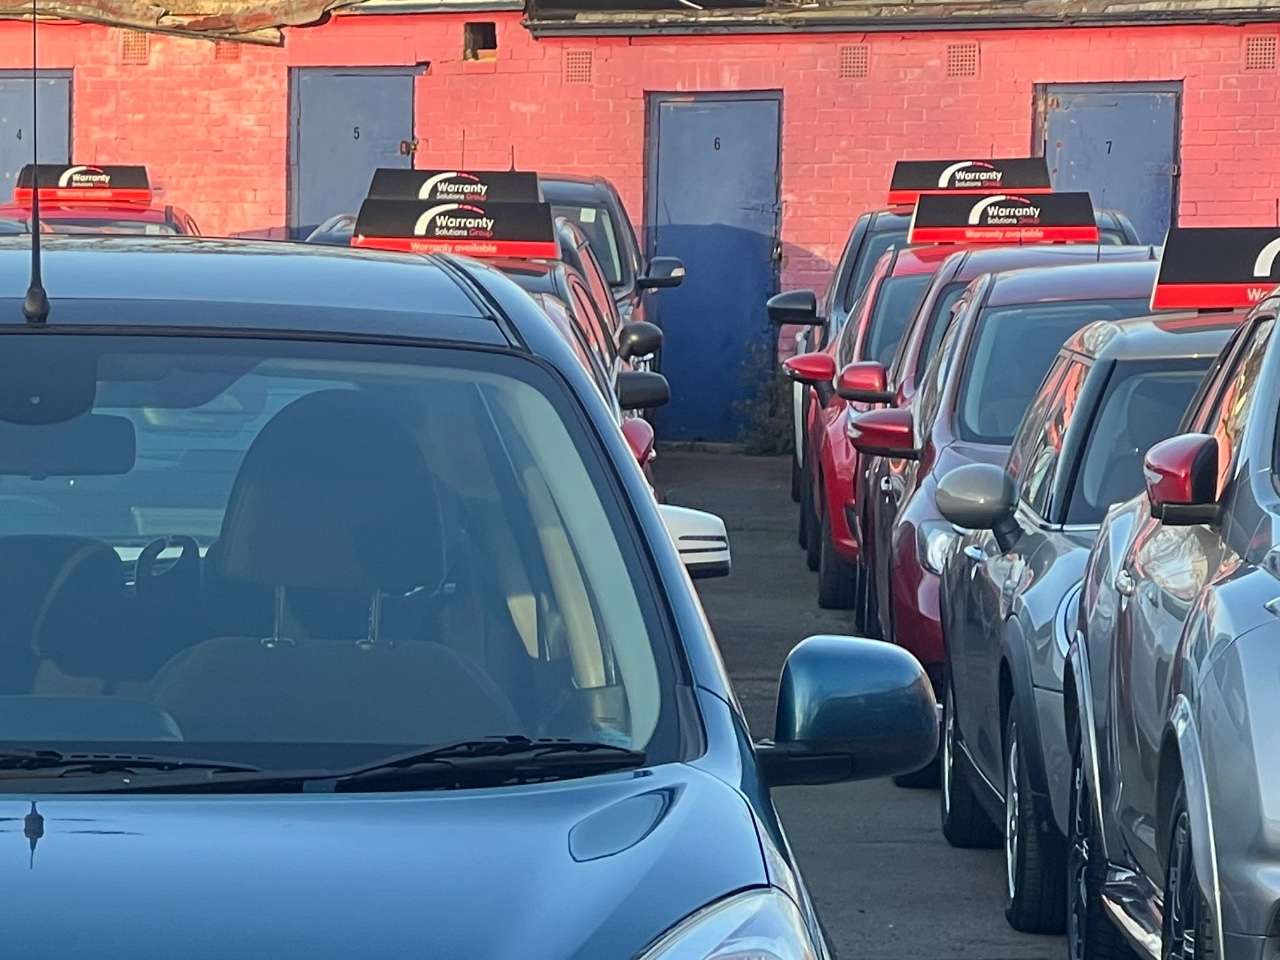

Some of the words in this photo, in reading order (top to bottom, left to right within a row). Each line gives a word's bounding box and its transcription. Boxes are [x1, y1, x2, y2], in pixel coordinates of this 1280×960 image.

[16, 128, 22, 140] 4
[354, 126, 360, 139] 5
[715, 136, 722, 150] 6
[1105, 140, 1112, 154] 7
[72, 173, 110, 184] Warranty
[955, 171, 1002, 182] Warranty
[437, 182, 488, 196] Warranty
[437, 192, 465, 200] Solutions
[987, 205, 1041, 218] Warranty
[435, 215, 494, 231] Warranty
[987, 216, 1018, 225] Solutions
[435, 228, 468, 236] Solutions
[468, 228, 494, 238] Group
[410, 242, 454, 253] Warranty
